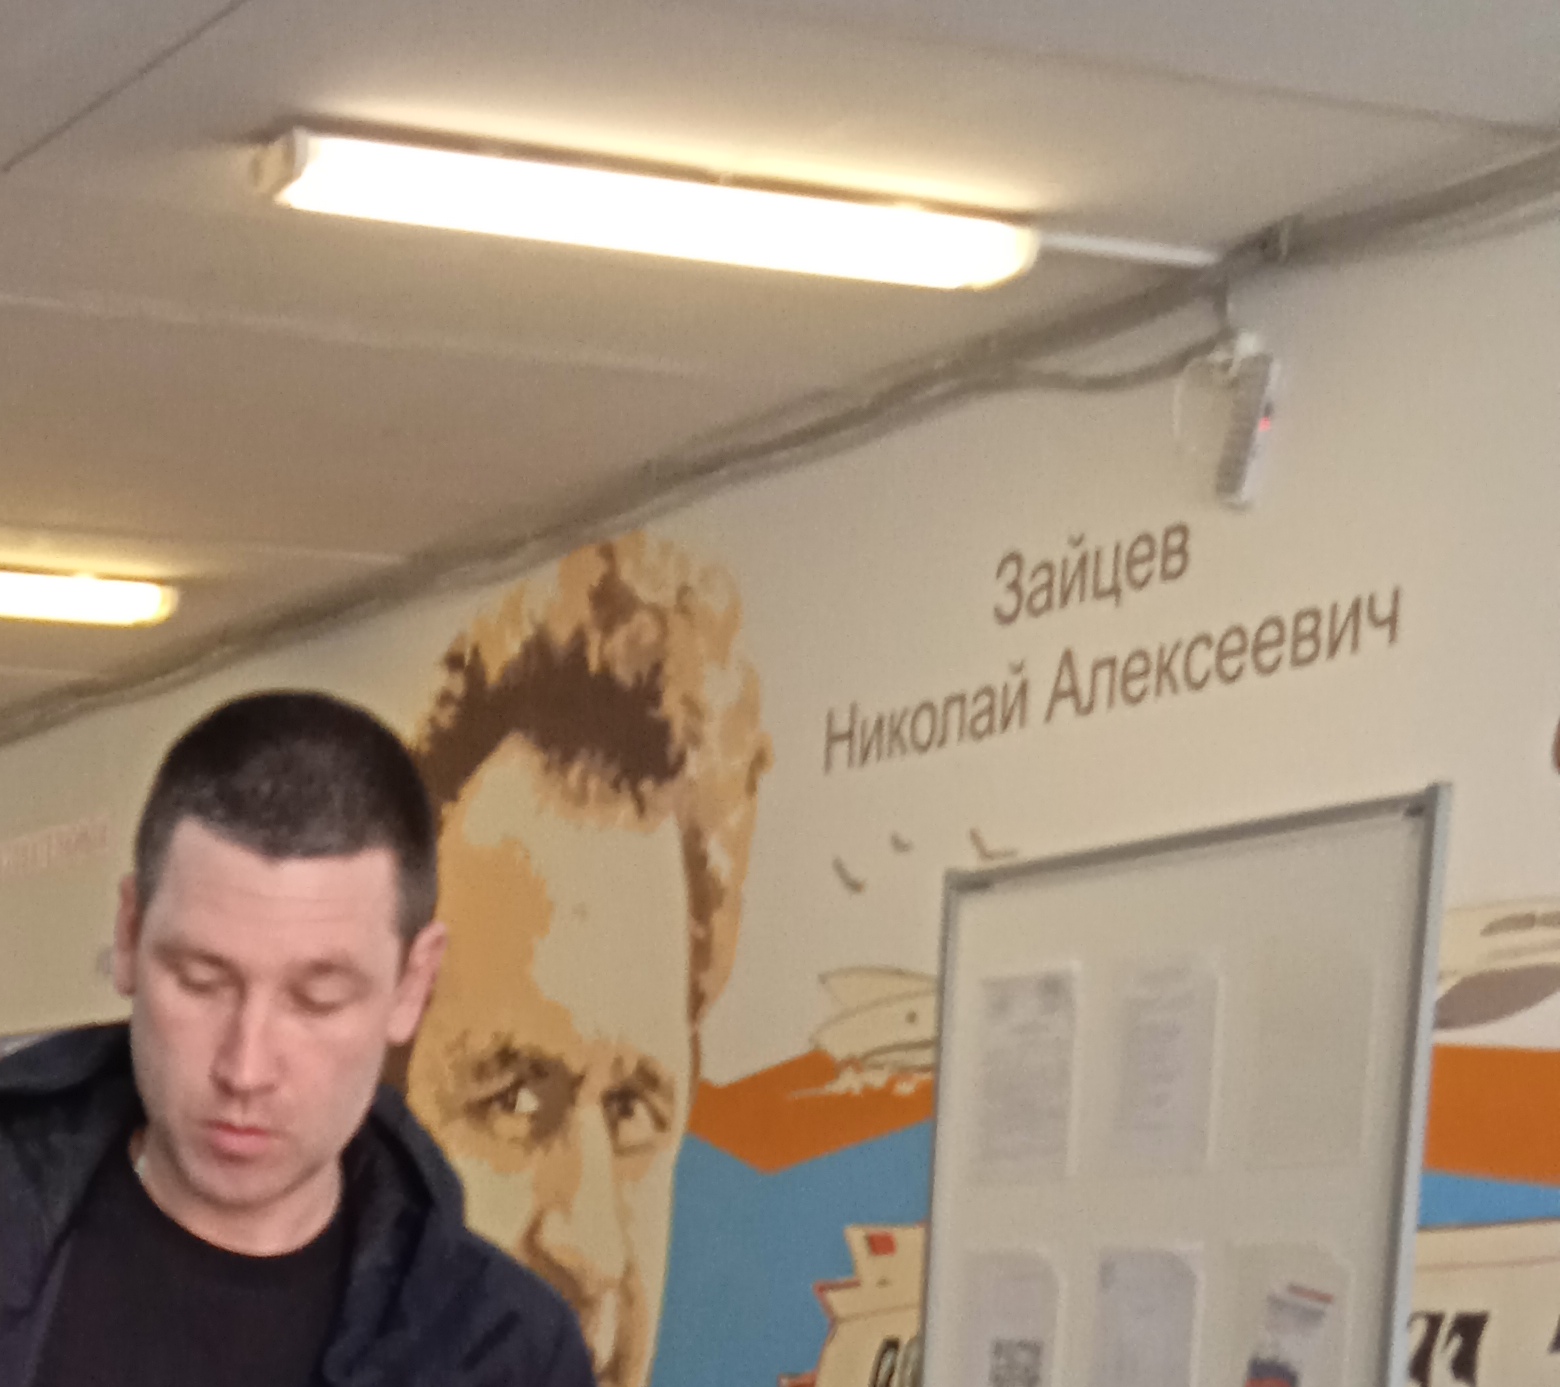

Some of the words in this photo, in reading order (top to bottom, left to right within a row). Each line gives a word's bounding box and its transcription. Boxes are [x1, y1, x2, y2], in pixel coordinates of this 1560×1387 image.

[993, 521, 1191, 626] Зайцев
[823, 659, 1031, 773] Николай
[1042, 586, 1402, 724] Алексеевич
